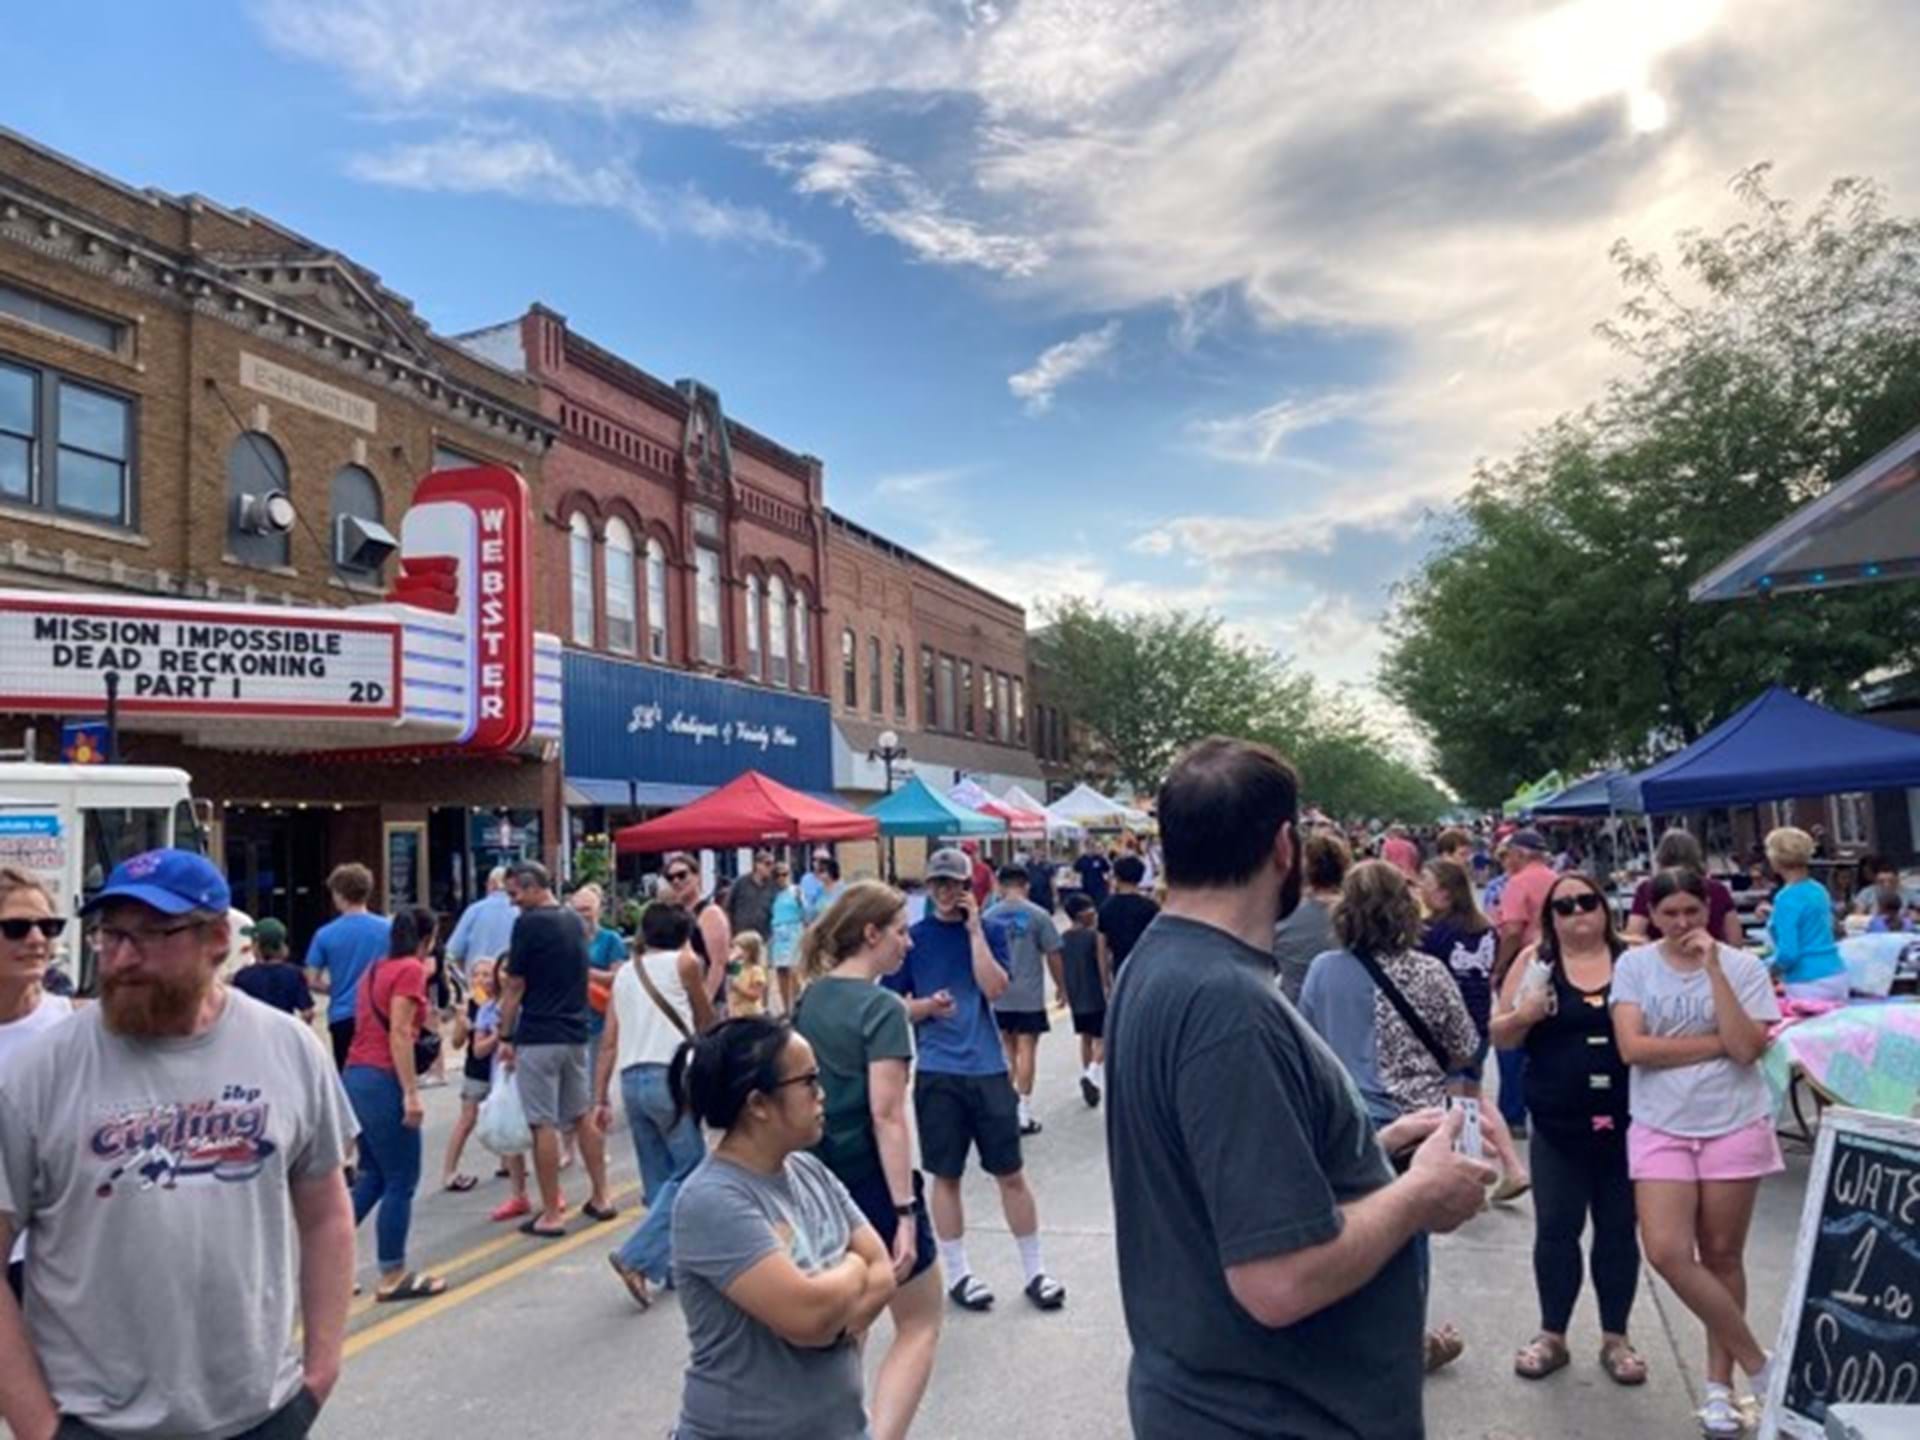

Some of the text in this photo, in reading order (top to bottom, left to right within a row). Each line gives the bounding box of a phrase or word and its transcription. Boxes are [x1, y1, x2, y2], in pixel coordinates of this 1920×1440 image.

[480, 508, 504, 719] WEBSTER
[34, 617, 341, 655] MISSION IMPOSSIBLE
[53, 644, 326, 678] DEAD RECKONING
[135, 675, 215, 698] PART
[349, 682, 384, 703] 2D
